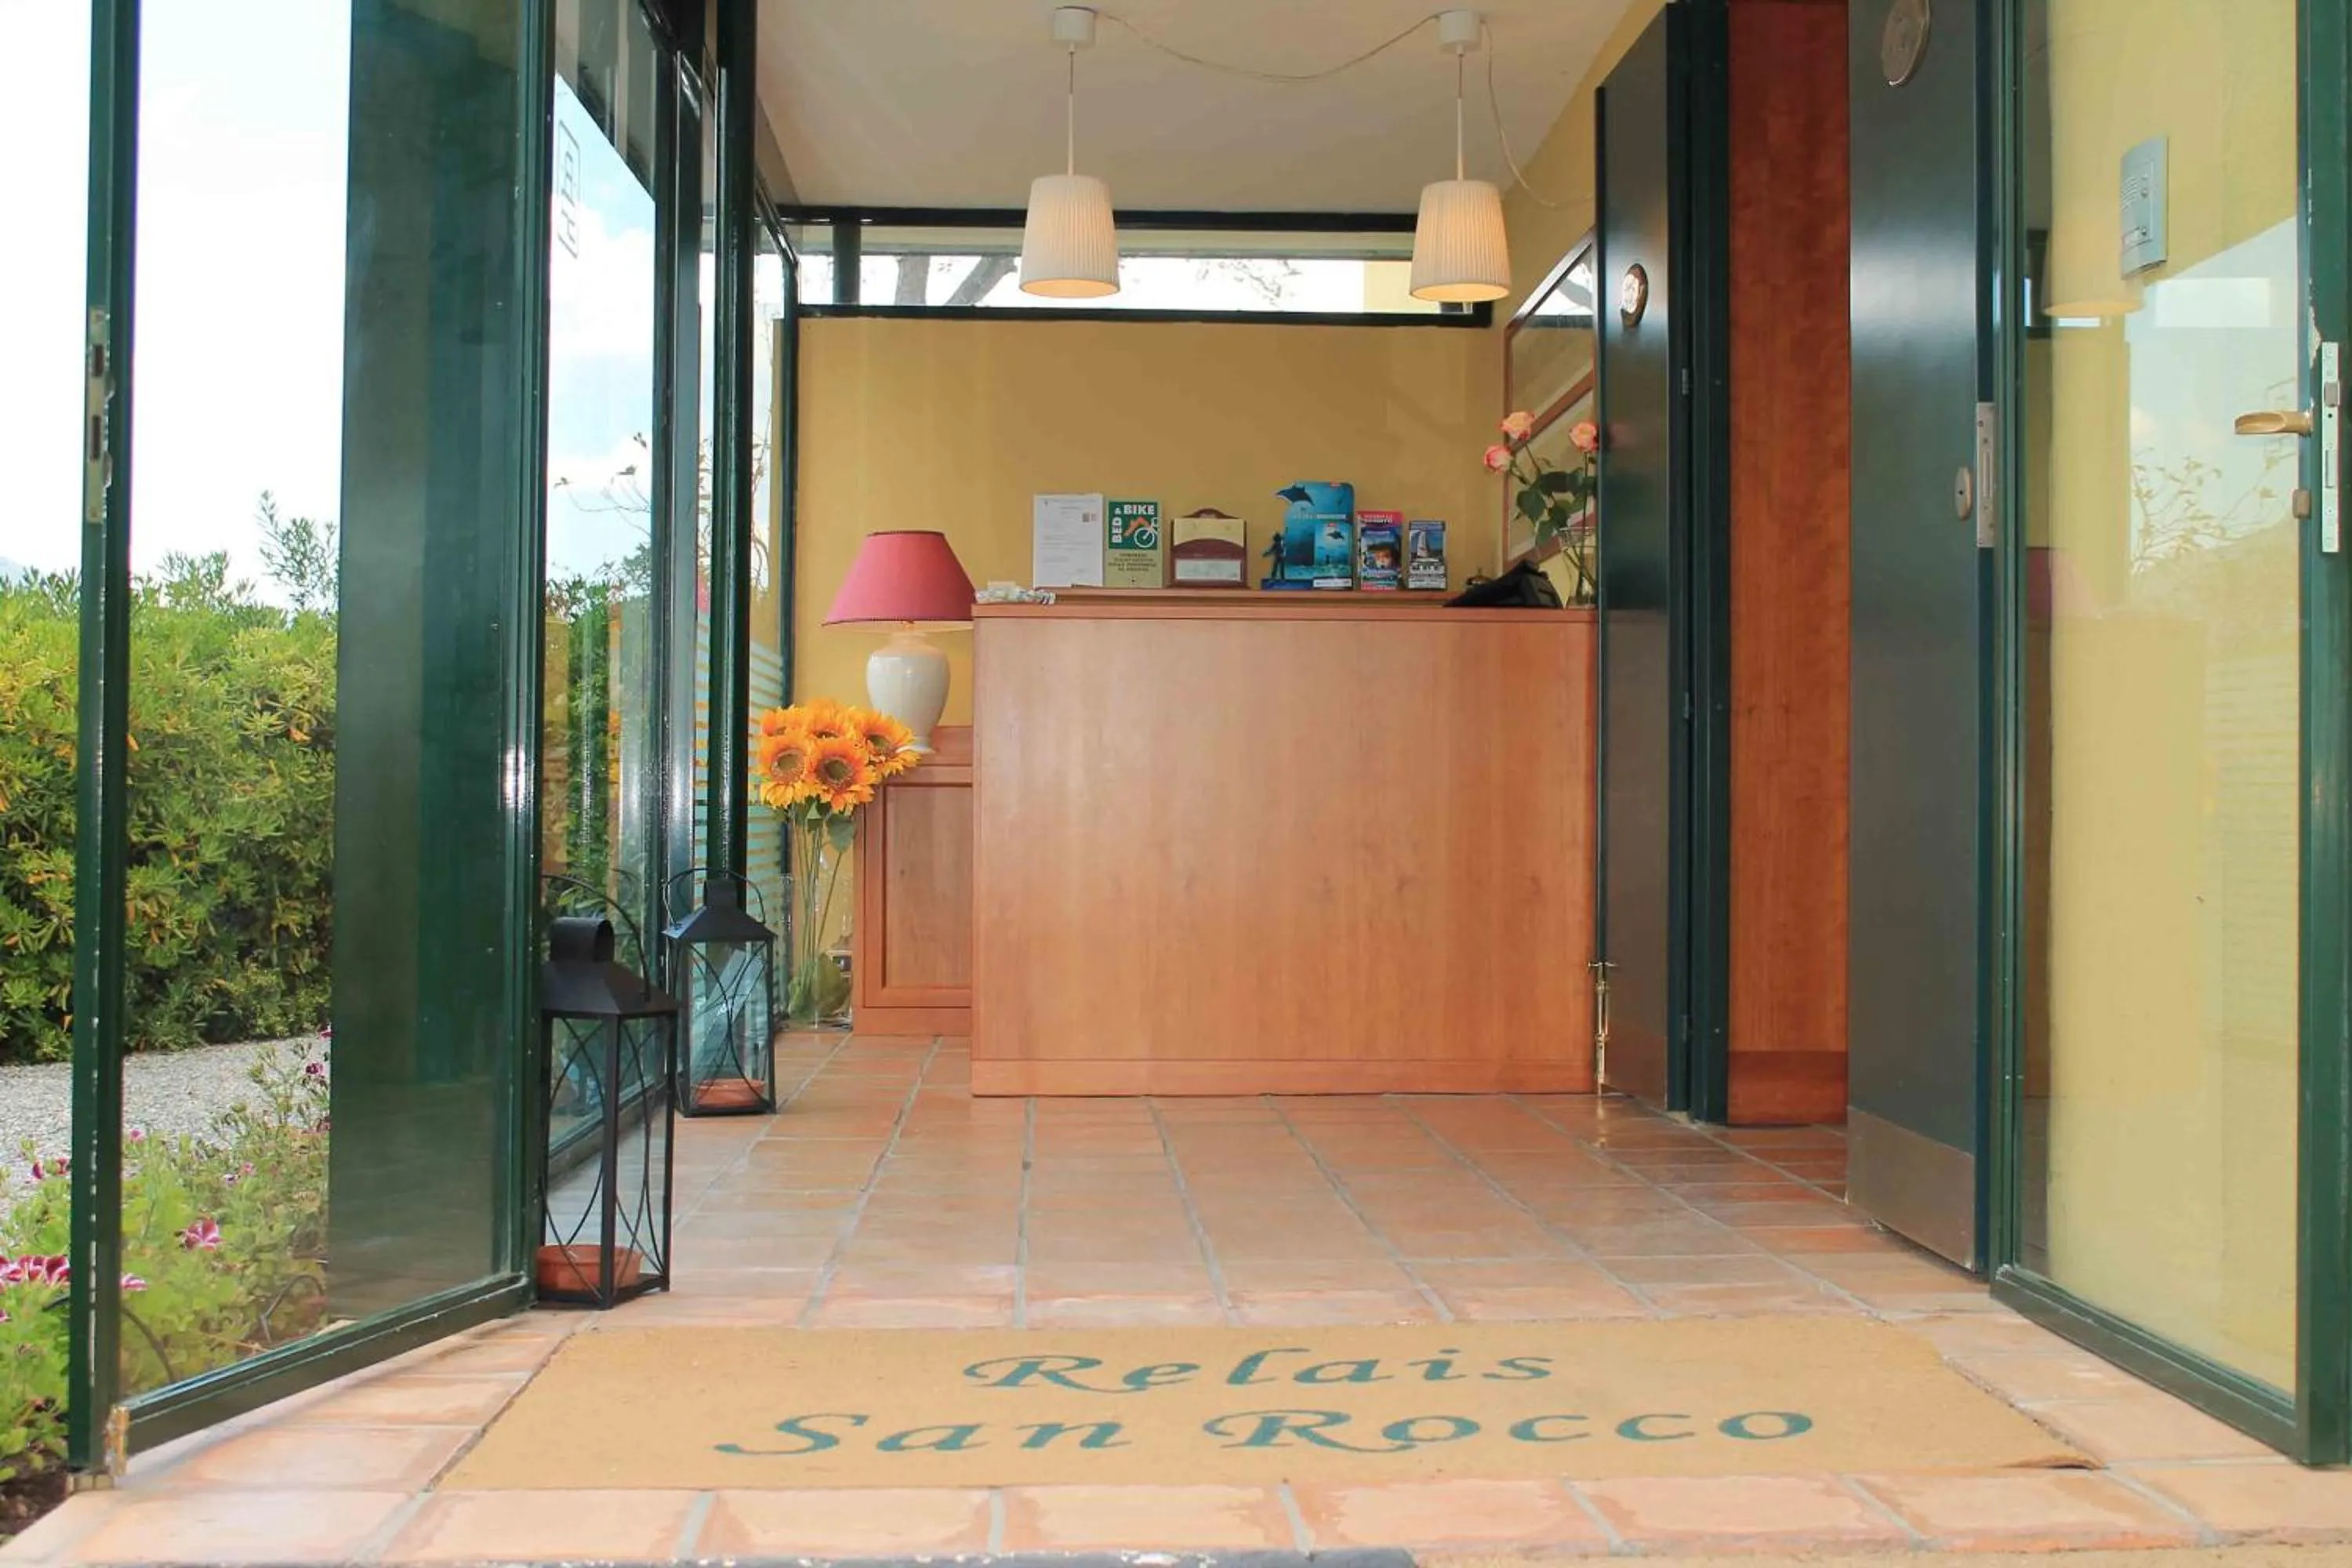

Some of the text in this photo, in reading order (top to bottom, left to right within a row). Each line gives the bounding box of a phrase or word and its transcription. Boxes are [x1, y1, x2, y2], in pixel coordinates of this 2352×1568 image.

[1112, 517, 1123, 543] BED
[1123, 504, 1155, 515] BIKE
[963, 1348, 1554, 1393] Relais
[713, 1410, 1814, 1454] San Rocco
